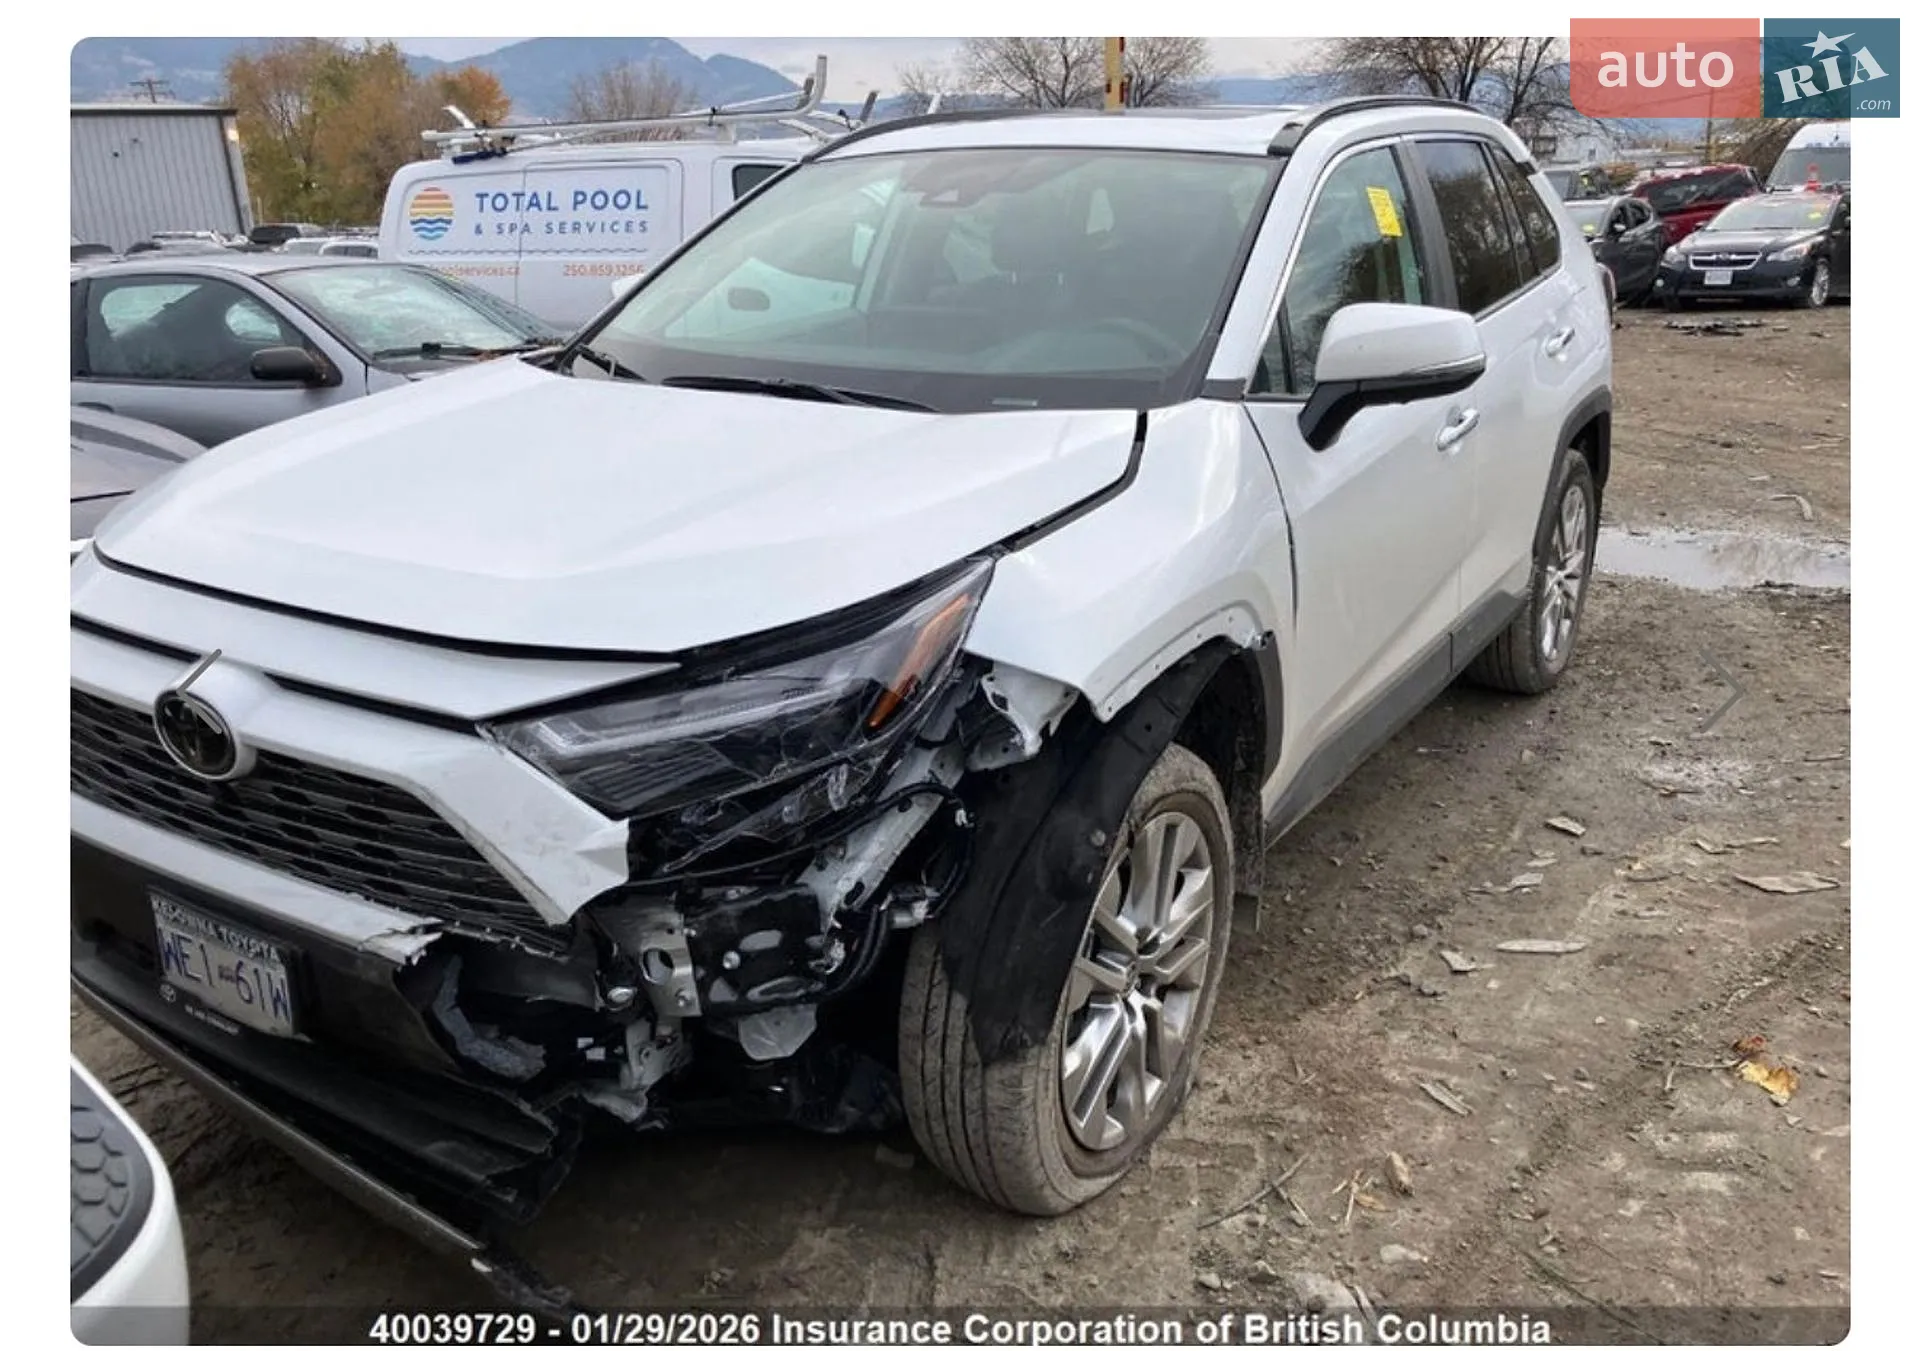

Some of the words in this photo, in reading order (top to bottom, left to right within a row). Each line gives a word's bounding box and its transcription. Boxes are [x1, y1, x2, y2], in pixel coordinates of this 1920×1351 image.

[475, 190, 560, 214] TOTAL
[572, 189, 649, 212] POOL
[474, 222, 484, 236] &
[496, 221, 533, 235] SPA
[545, 219, 650, 235] SERVICES
